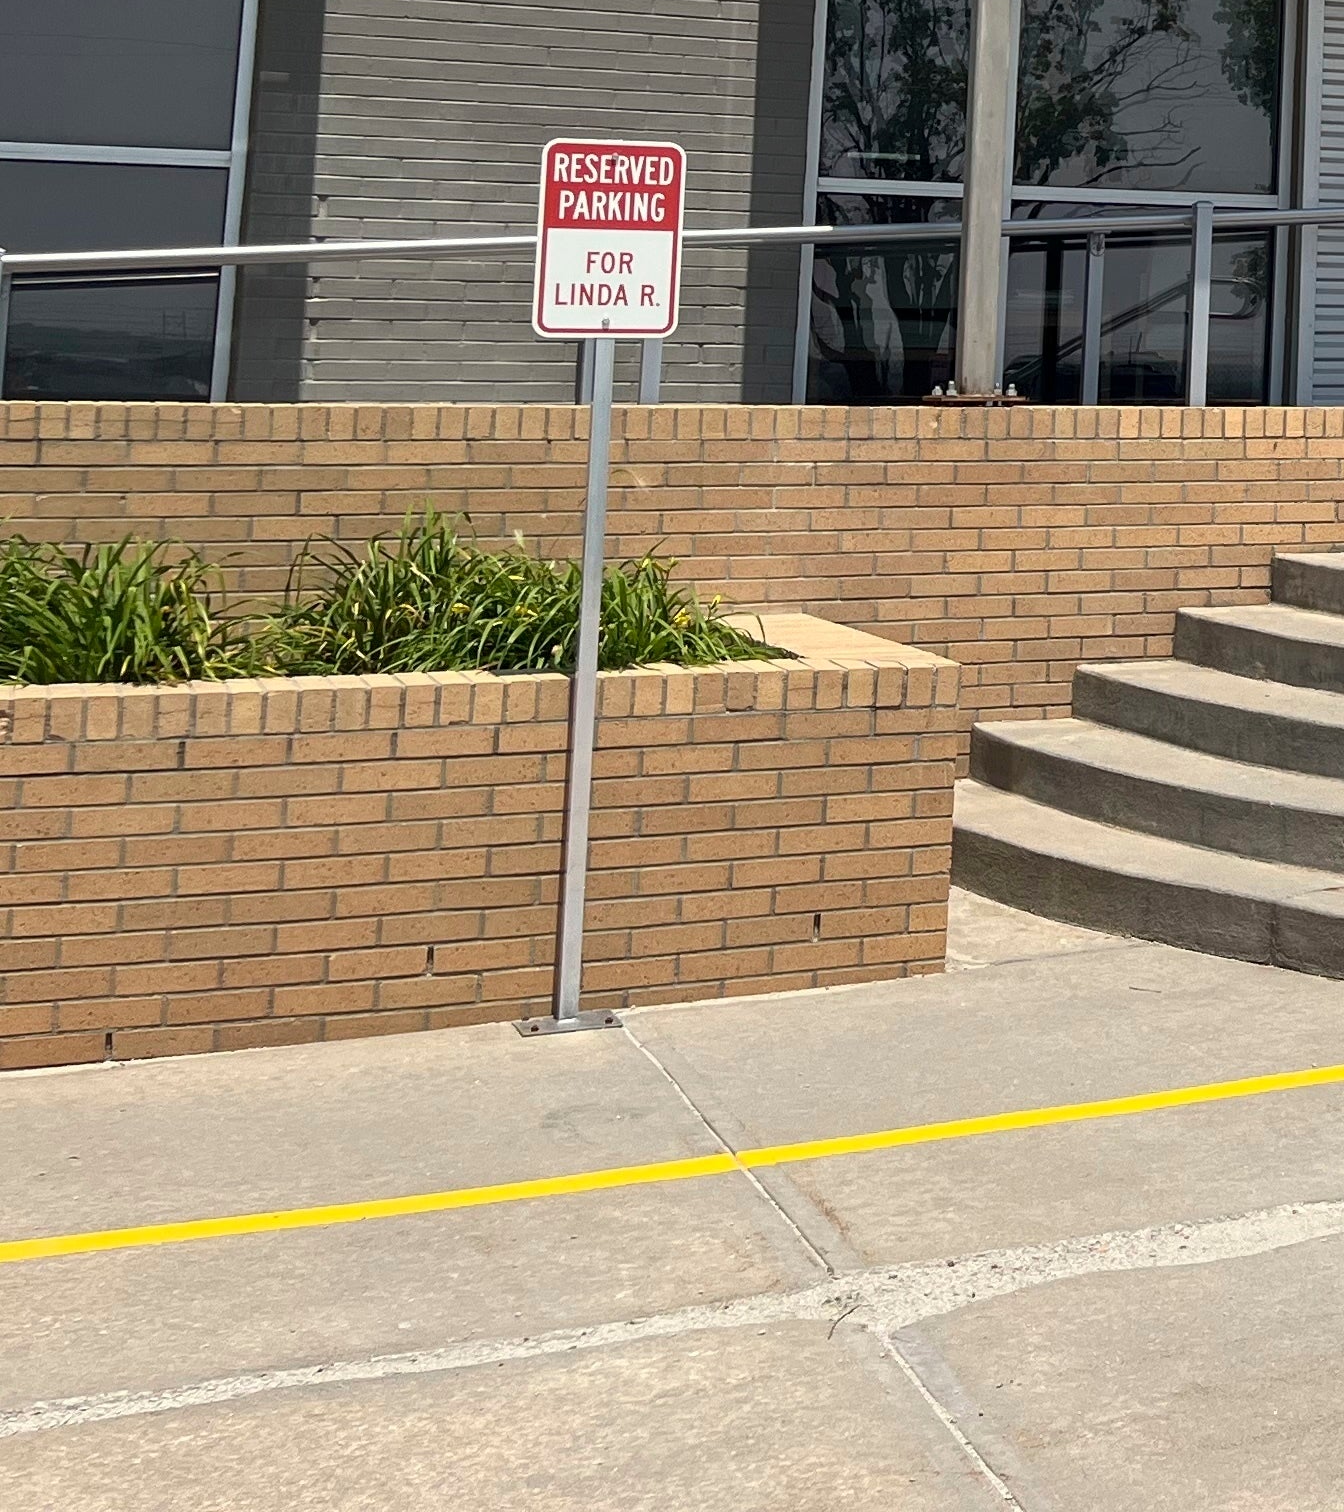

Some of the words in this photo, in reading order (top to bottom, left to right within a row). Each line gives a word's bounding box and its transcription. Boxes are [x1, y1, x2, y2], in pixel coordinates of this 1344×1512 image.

[553, 152, 674, 186] RESERVED
[558, 190, 666, 222] PARKING
[586, 251, 634, 274] FOR
[554, 283, 629, 306] LINDA
[640, 284, 661, 307] R.
